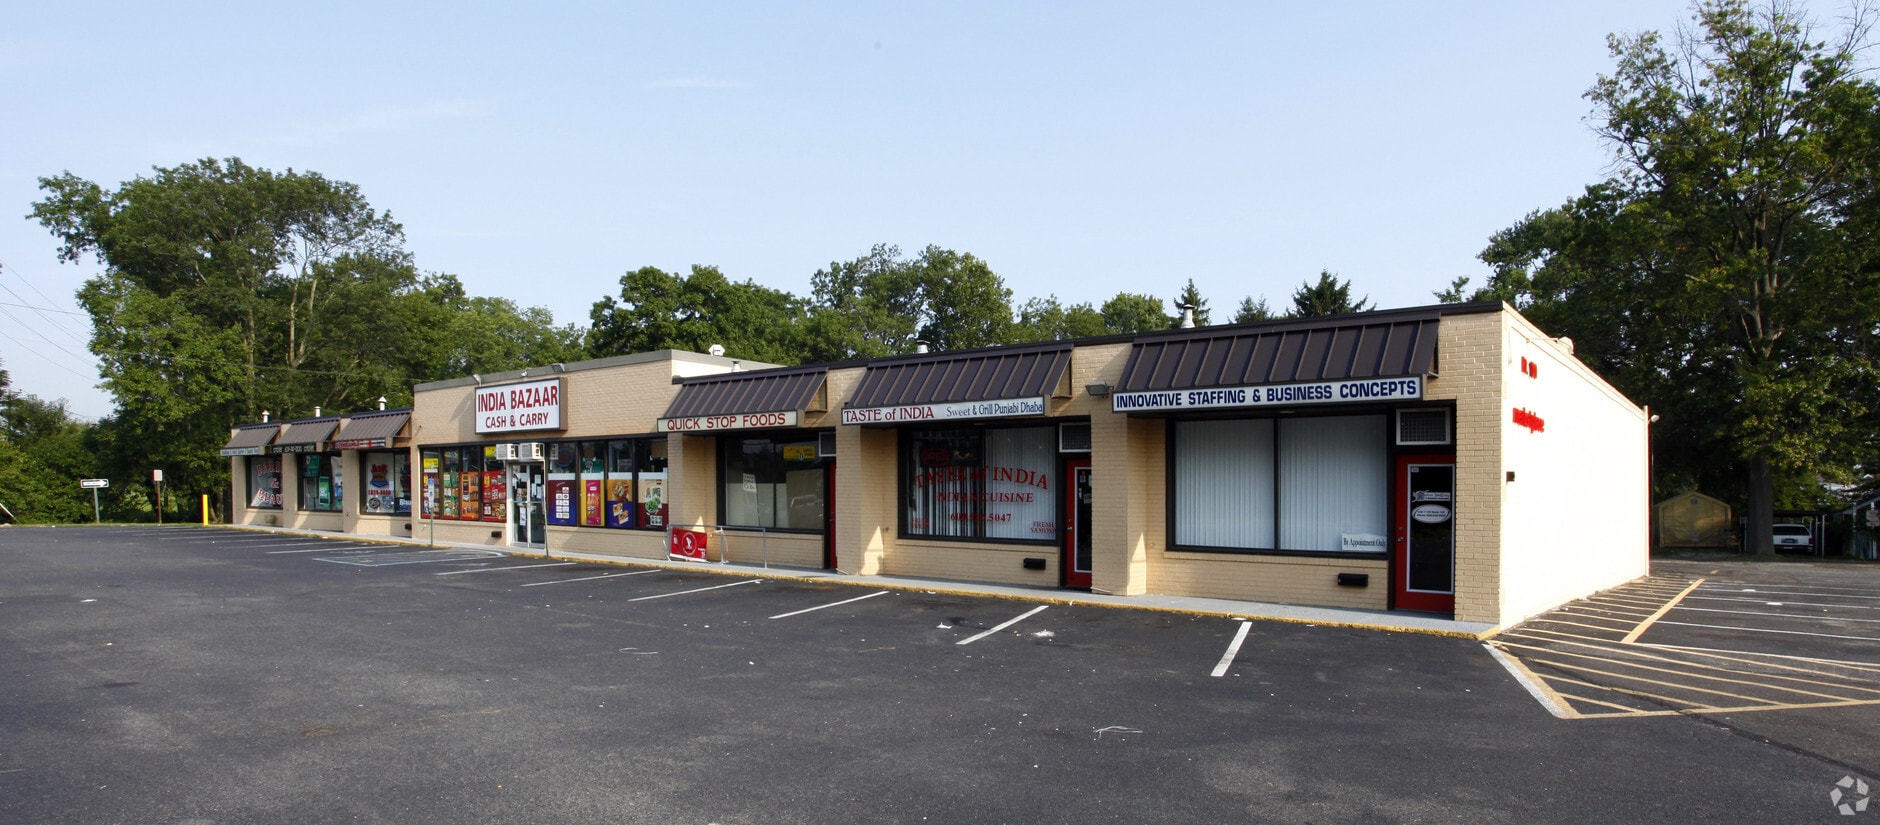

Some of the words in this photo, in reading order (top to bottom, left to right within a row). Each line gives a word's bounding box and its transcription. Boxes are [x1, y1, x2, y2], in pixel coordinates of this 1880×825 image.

[478, 391, 506, 412] INDIA
[510, 385, 558, 409] BAZAAR
[1116, 393, 1182, 409] INNOVATIVE
[1188, 389, 1246, 405] STAFFING
[1252, 388, 1261, 403] &
[1266, 385, 1332, 402] BUSINESS
[1340, 380, 1416, 398] CONCEPTS
[485, 415, 507, 428] CASH
[510, 414, 516, 427] &
[520, 412, 549, 426] CARRY
[667, 418, 700, 430] QUICK
[706, 416, 737, 428] STOP
[743, 413, 786, 427] FOODS
[844, 408, 882, 422] TASTE
[885, 408, 896, 420] of
[900, 406, 934, 420] INDIA
[946, 405, 970, 418] Sweet
[972, 404, 977, 415] &
[979, 403, 993, 415] Grill
[994, 402, 1019, 415] Punjabi
[1020, 401, 1043, 413] Dhaba
[914, 466, 967, 489] TASTE
[970, 466, 989, 481] of
[993, 466, 1049, 490] INDIA
[981, 492, 1034, 503] CUISINE
